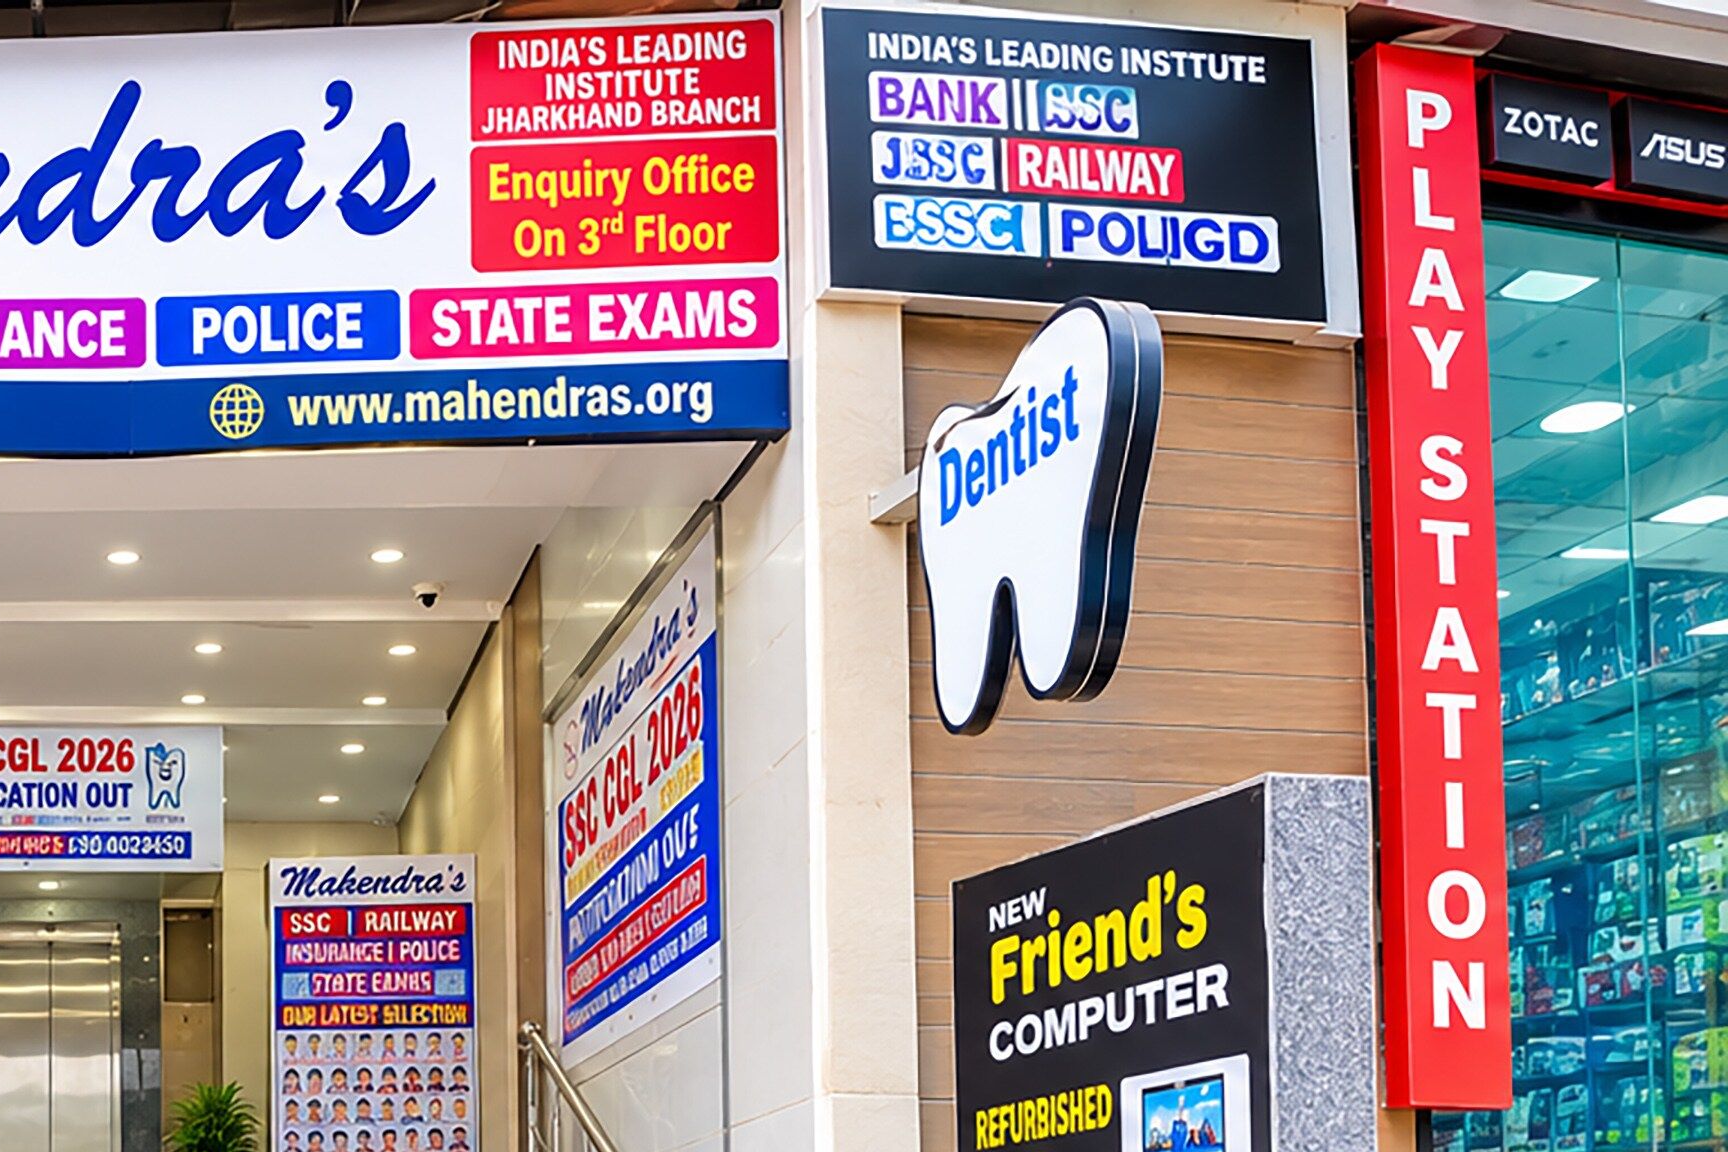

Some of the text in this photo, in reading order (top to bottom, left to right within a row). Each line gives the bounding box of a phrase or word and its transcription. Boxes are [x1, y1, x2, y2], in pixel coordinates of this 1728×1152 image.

[497, 29, 747, 69] INDIA'S LEADING
[868, 33, 977, 64] INDIA'S
[986, 39, 1113, 73] LEADING
[545, 68, 699, 101] INSTITUTE
[878, 77, 1001, 125] BANK
[480, 94, 761, 134] JHARKHAND BRANCH
[1504, 106, 1599, 147] ZOTAC
[1018, 143, 1175, 196] RAILWAY
[1640, 133, 1725, 169] ASUS
[489, 151, 754, 209] Enquiry Office
[513, 212, 732, 259] On 3rd Floor
[1405, 88, 1466, 390] PLAY
[192, 301, 364, 355] POLICE
[431, 288, 757, 347] STATE EXAMS
[288, 375, 714, 428] www.mahendras.org
[939, 365, 1080, 527] Dentist
[57, 737, 135, 773] 2026
[1420, 435, 1486, 1030] STATION
[565, 777, 599, 868] SSC
[603, 734, 642, 828] CGL
[647, 665, 700, 787] 2026
[85, 782, 133, 809] OUT
[290, 910, 457, 934] SSC RAILWAY
[988, 886, 1046, 933] NEW
[990, 869, 1208, 1004] Friend's
[988, 963, 1230, 1061] COMPUTER
[976, 1084, 1113, 1150] REFURBISHED
